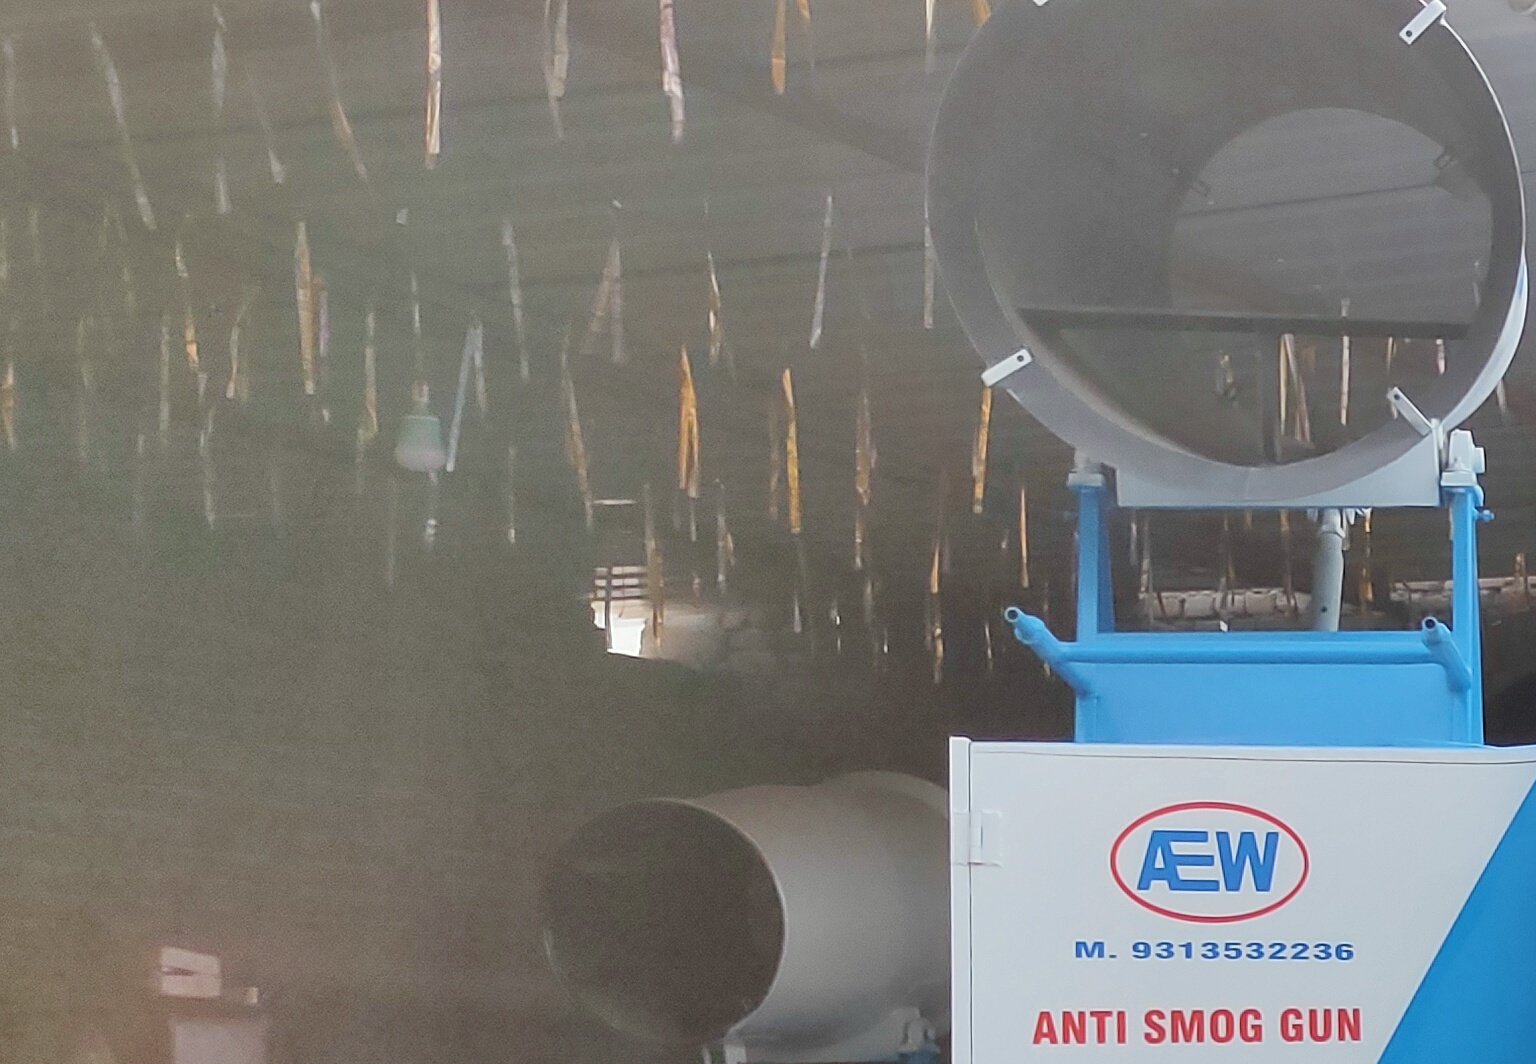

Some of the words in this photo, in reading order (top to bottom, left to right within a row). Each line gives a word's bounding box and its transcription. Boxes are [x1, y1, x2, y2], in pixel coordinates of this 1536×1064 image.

[1074, 940, 1118, 960] M.
[1131, 941, 1356, 962] 9313532236
[1031, 1010, 1128, 1046] ANTI
[1142, 1008, 1264, 1044] SMOG
[1279, 1007, 1363, 1043] GUN
